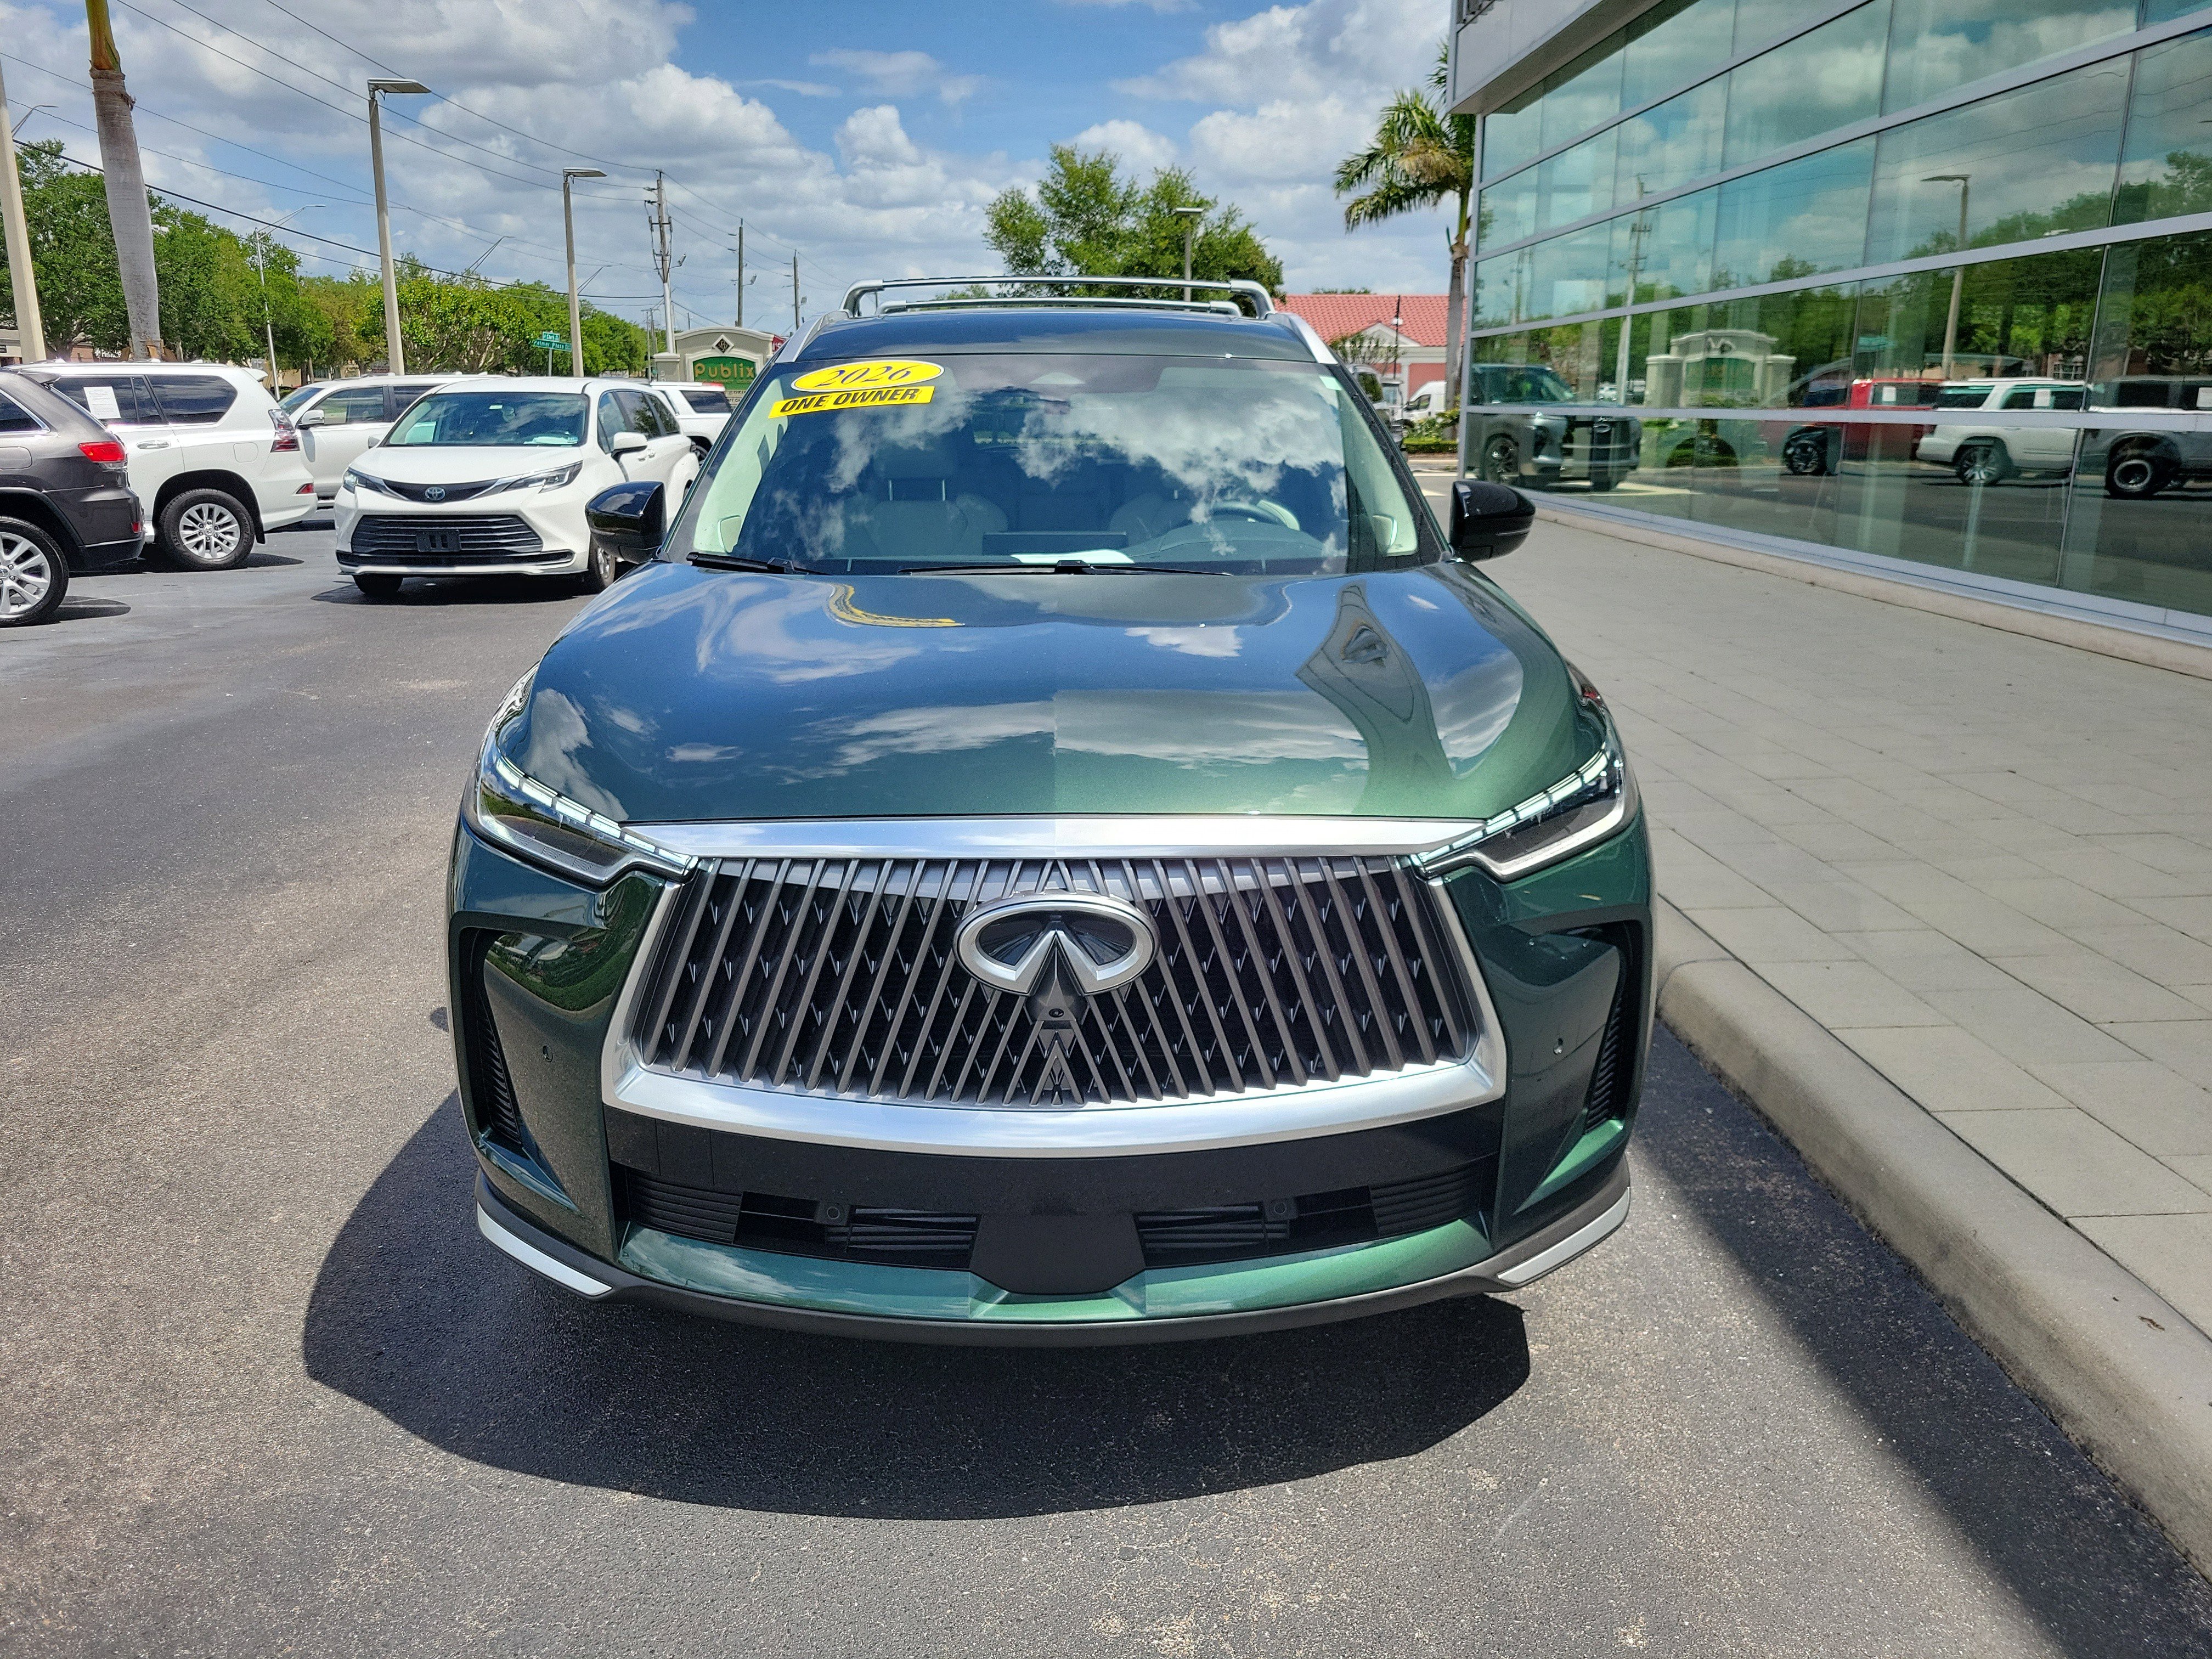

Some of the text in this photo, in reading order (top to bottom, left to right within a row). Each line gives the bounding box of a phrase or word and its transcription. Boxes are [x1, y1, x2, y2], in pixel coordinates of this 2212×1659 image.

[695, 363, 754, 378] Publix
[814, 365, 919, 387] 2026
[780, 388, 920, 413] ONE OWNER
